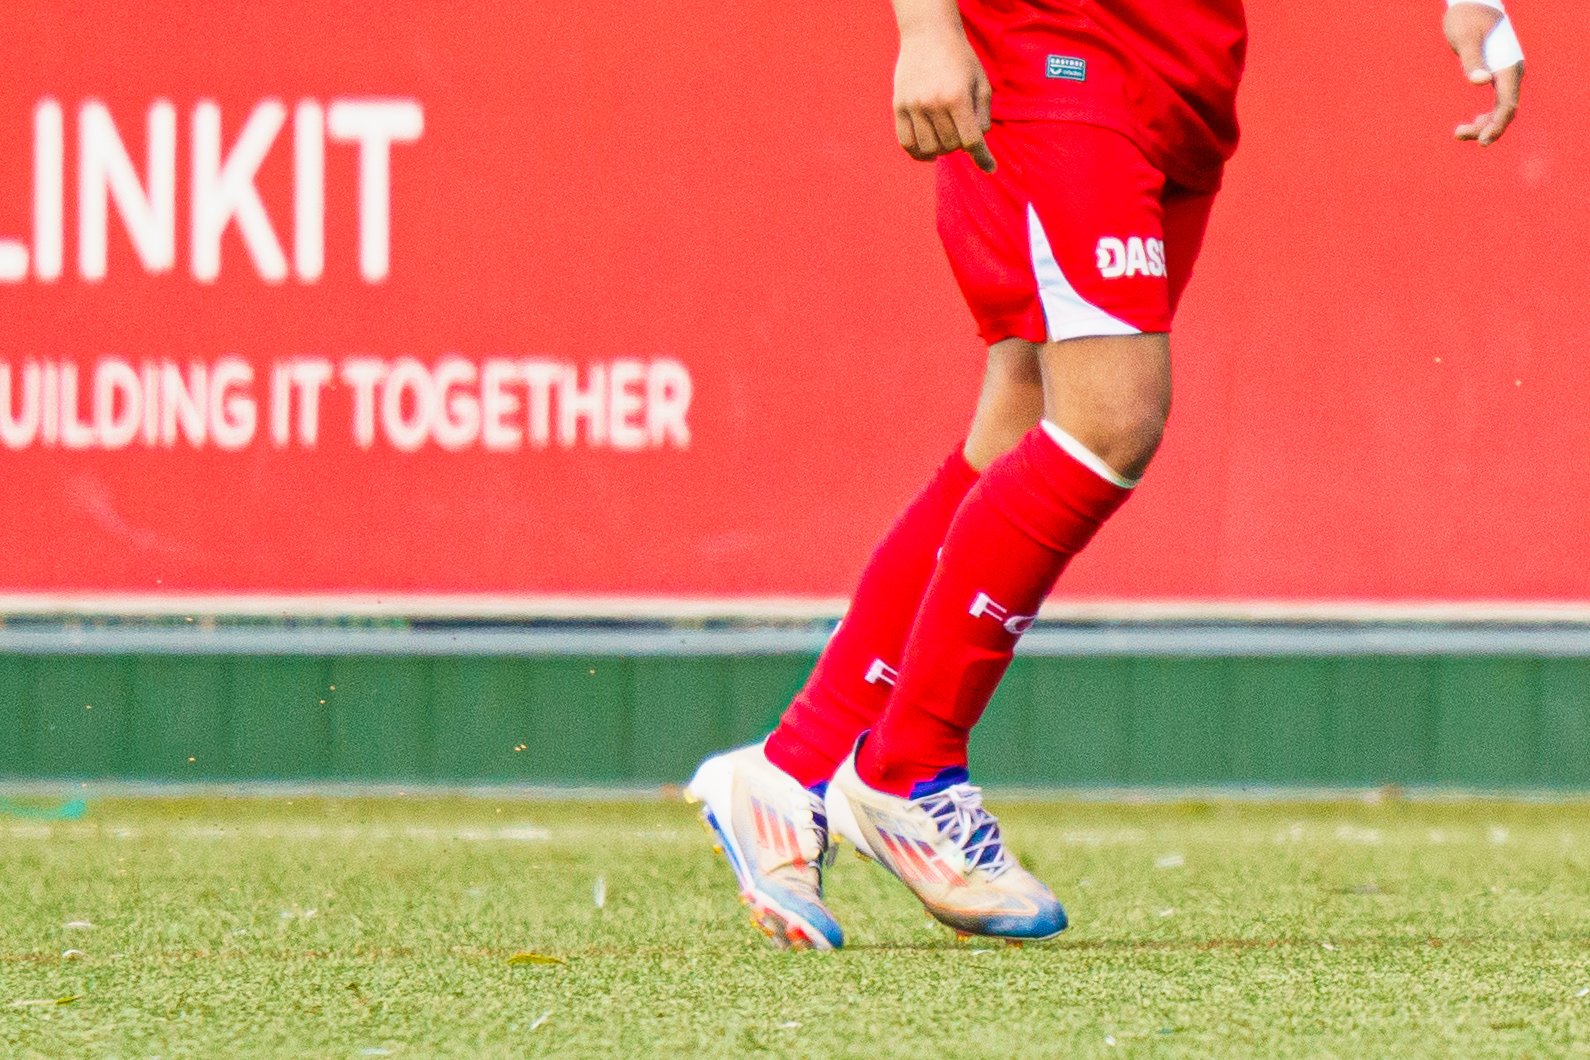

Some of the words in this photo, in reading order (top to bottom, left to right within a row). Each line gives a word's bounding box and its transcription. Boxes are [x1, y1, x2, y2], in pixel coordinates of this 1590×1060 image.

[1096, 236, 1167, 278] DAS
[271, 357, 332, 450] IT
[339, 357, 694, 451] TOGETHER
